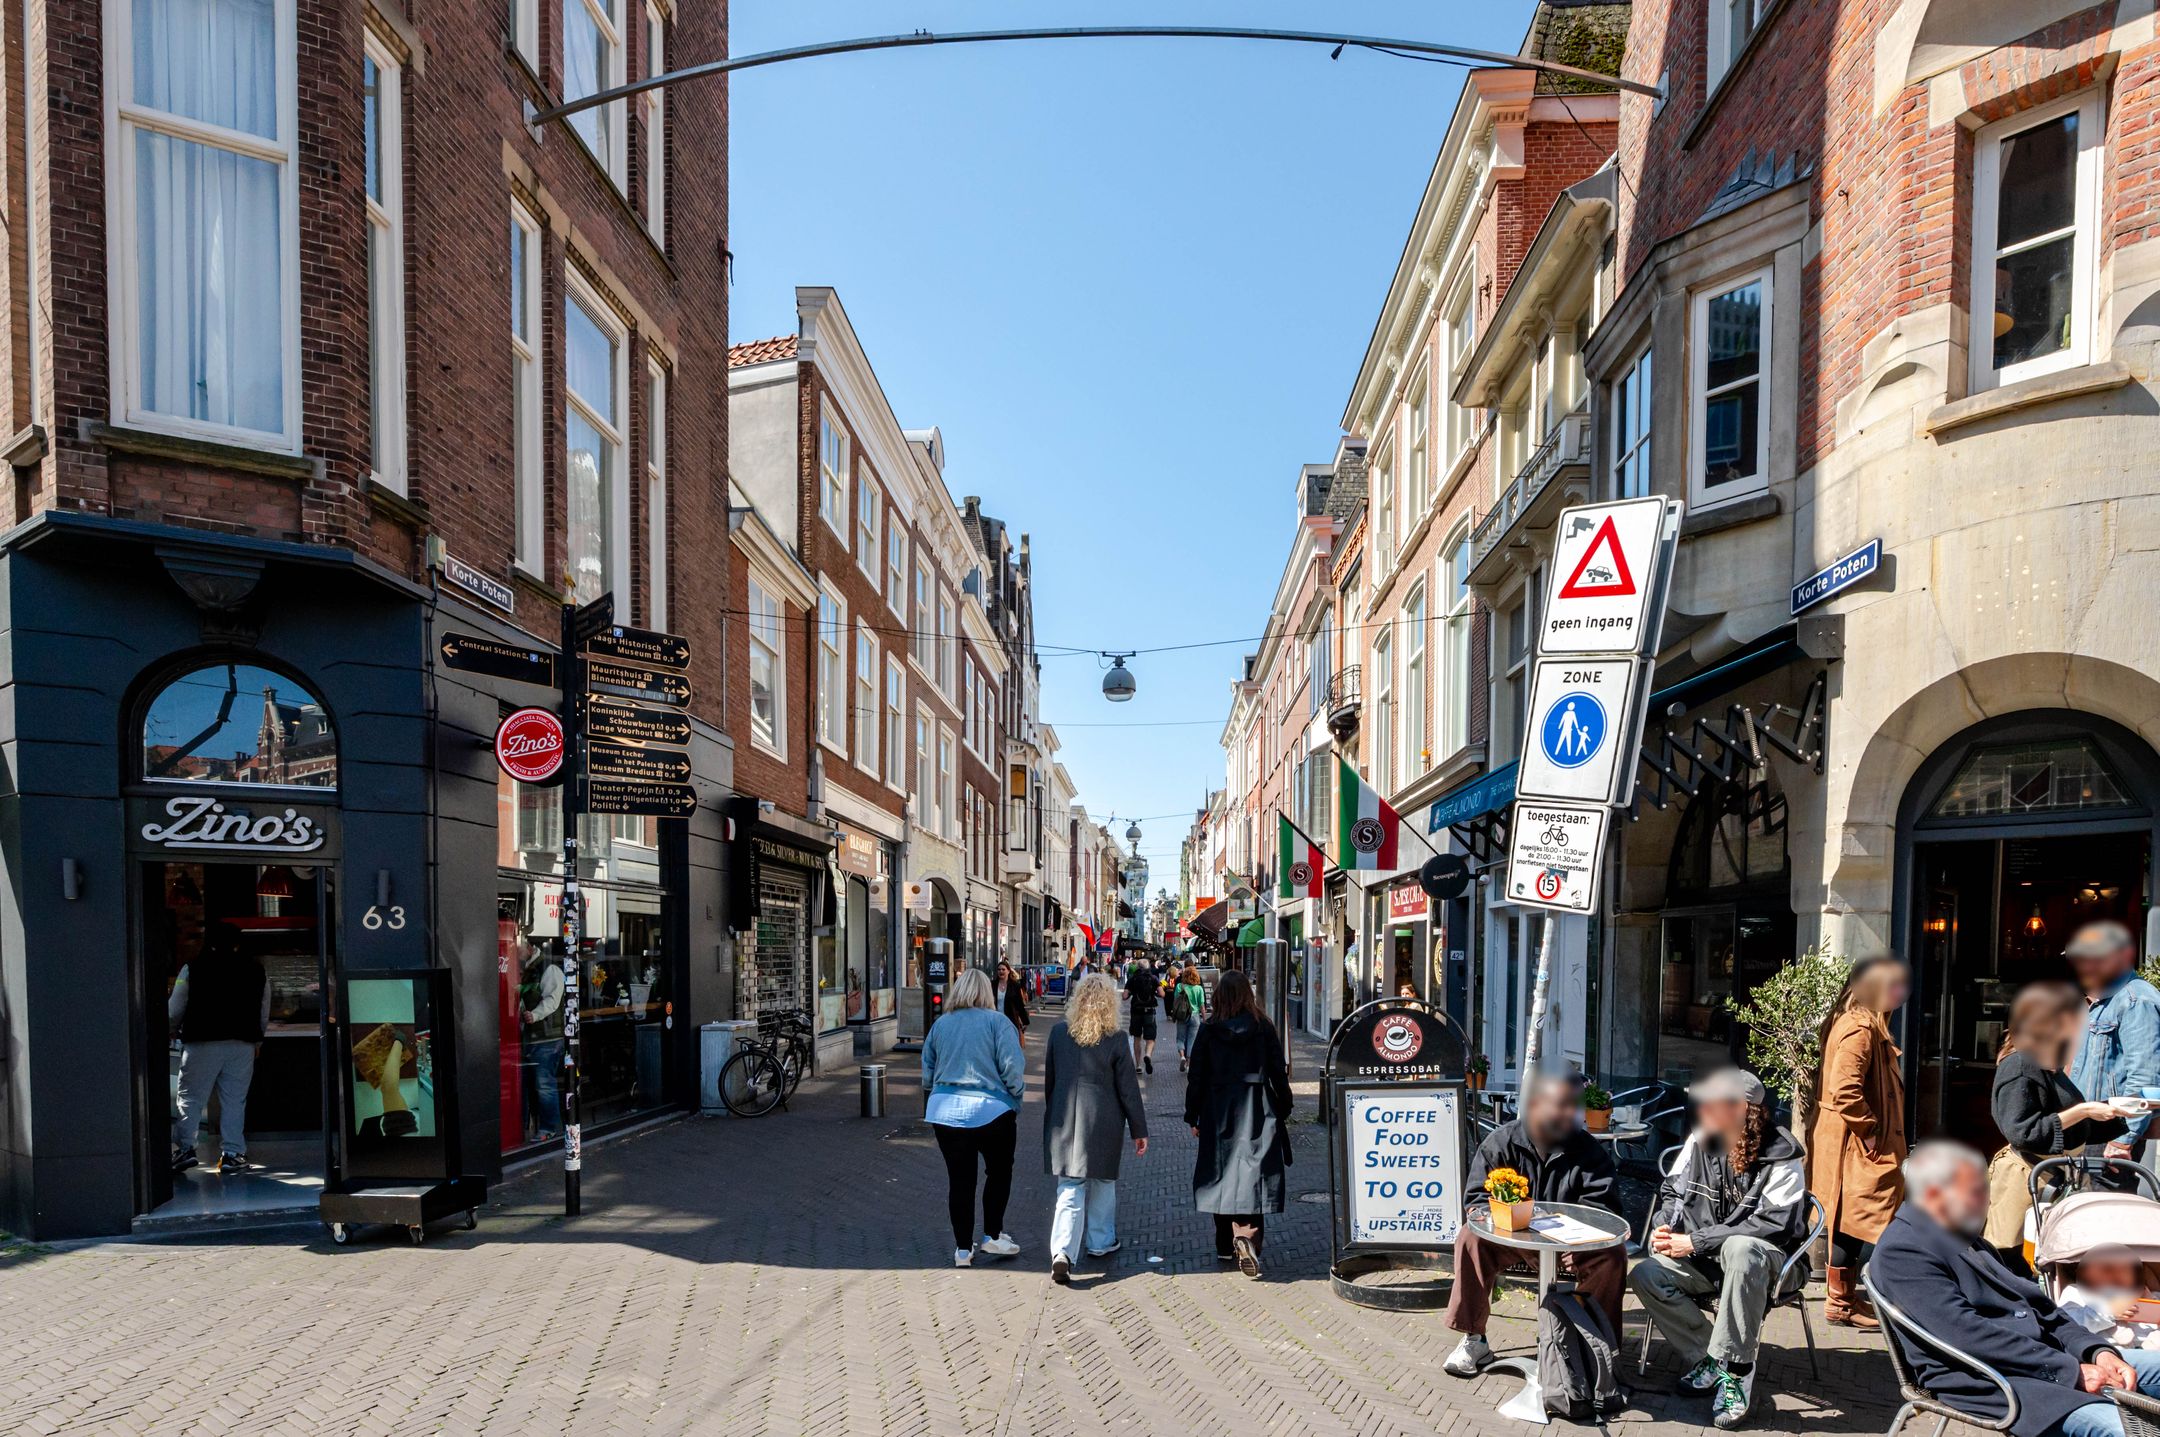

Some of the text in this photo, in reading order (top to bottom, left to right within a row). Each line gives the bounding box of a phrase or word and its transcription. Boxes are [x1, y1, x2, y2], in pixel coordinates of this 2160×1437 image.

[451, 562, 508, 605] Korte Poten
[1798, 554, 1868, 603] Korte Poten
[1551, 616, 1633, 633] geen ingang
[459, 640, 492, 652] Centraal
[494, 647, 521, 658] Station
[617, 646, 651, 658] Museum
[619, 638, 662, 652] Historisch
[591, 665, 642, 679] Mauritshuis
[1562, 671, 1602, 683] ZONE
[591, 674, 635, 687] Binnenhof
[591, 706, 634, 718] Koninklijke
[591, 723, 615, 733] Lange
[617, 727, 653, 738] Voorhout
[610, 718, 655, 730] Schouwburg
[503, 732, 561, 758] Zino's
[591, 746, 645, 758] Museum Escher
[510, 762, 527, 775] FRESH
[591, 763, 624, 773] Museum
[626, 767, 655, 777] Bredius
[637, 760, 656, 769] Paleis
[592, 784, 625, 793] Theater
[627, 785, 654, 795] Pepijn
[592, 793, 621, 801] Theater
[623, 795, 659, 804] Diligentia
[592, 801, 621, 810] Politie
[141, 797, 323, 851] Zino's
[1527, 810, 1590, 825] toegestaan:
[1362, 827, 1373, 843] S
[1520, 844, 1543, 853] dagelijks
[1516, 858, 1546, 868] snorfietsen
[1558, 863, 1589, 872] toegestaan
[1296, 868, 1305, 880] S
[1542, 878, 1555, 892] 15
[362, 905, 406, 930] 63
[1378, 1045, 1418, 1061] ALMONDO
[1358, 1064, 1441, 1076] ESPRESSOBAR
[1365, 1106, 1437, 1124] COFFEE
[1374, 1128, 1429, 1146] FOOD
[1364, 1150, 1440, 1168] SWEETS
[1364, 1181, 1443, 1199] TO GO
[1410, 1212, 1442, 1220] SEATS
[1368, 1220, 1443, 1232] UPSTAIRS
